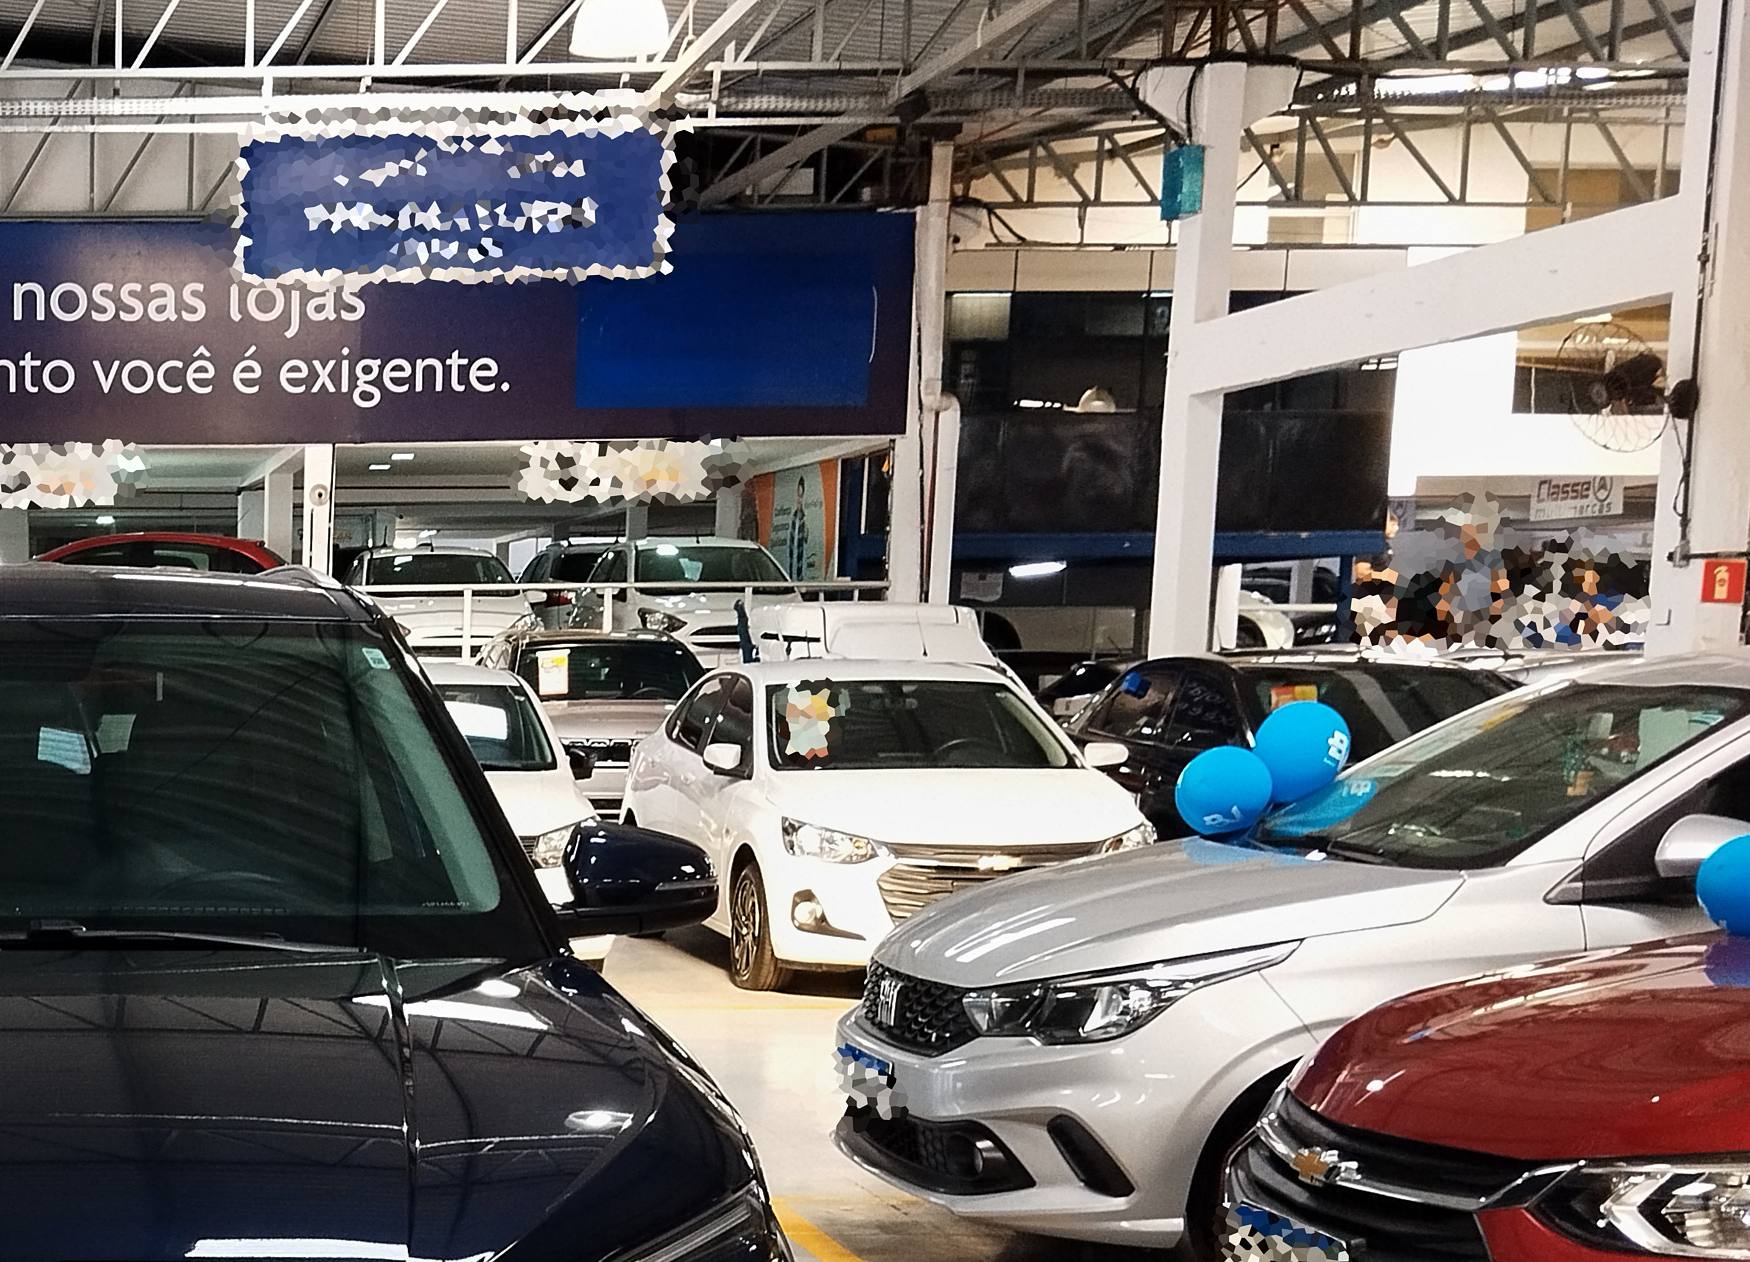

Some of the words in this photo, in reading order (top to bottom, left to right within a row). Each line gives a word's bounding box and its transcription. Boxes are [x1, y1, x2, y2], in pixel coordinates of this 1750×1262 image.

[13, 281, 207, 322] nossas
[92, 345, 215, 394] você
[232, 345, 262, 394] é
[279, 347, 511, 408] exigente.
[1536, 479, 1592, 503] Classe
[1534, 502, 1613, 519] mularcas
